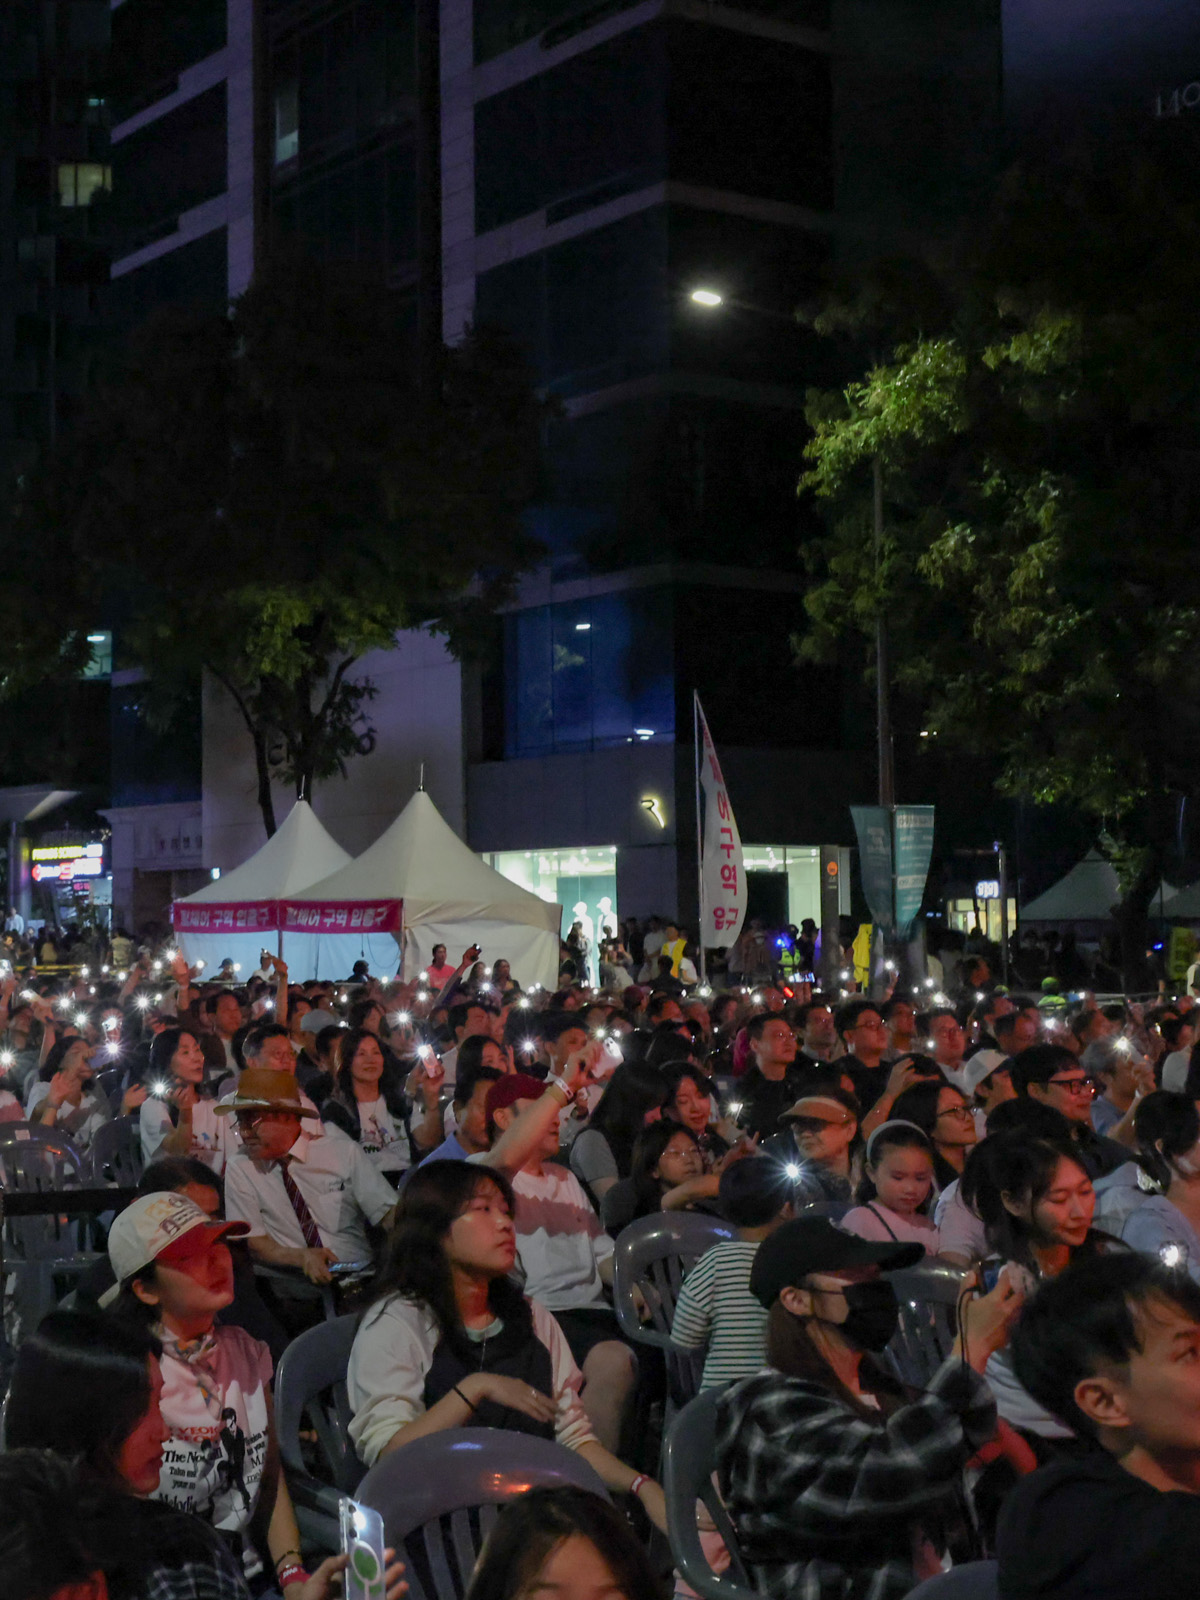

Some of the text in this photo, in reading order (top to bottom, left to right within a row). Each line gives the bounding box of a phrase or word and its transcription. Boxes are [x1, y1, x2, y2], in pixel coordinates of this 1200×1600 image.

[213, 909, 234, 927] 구역
[323, 908, 348, 927] 구역
[164, 1450, 186, 1463] The
